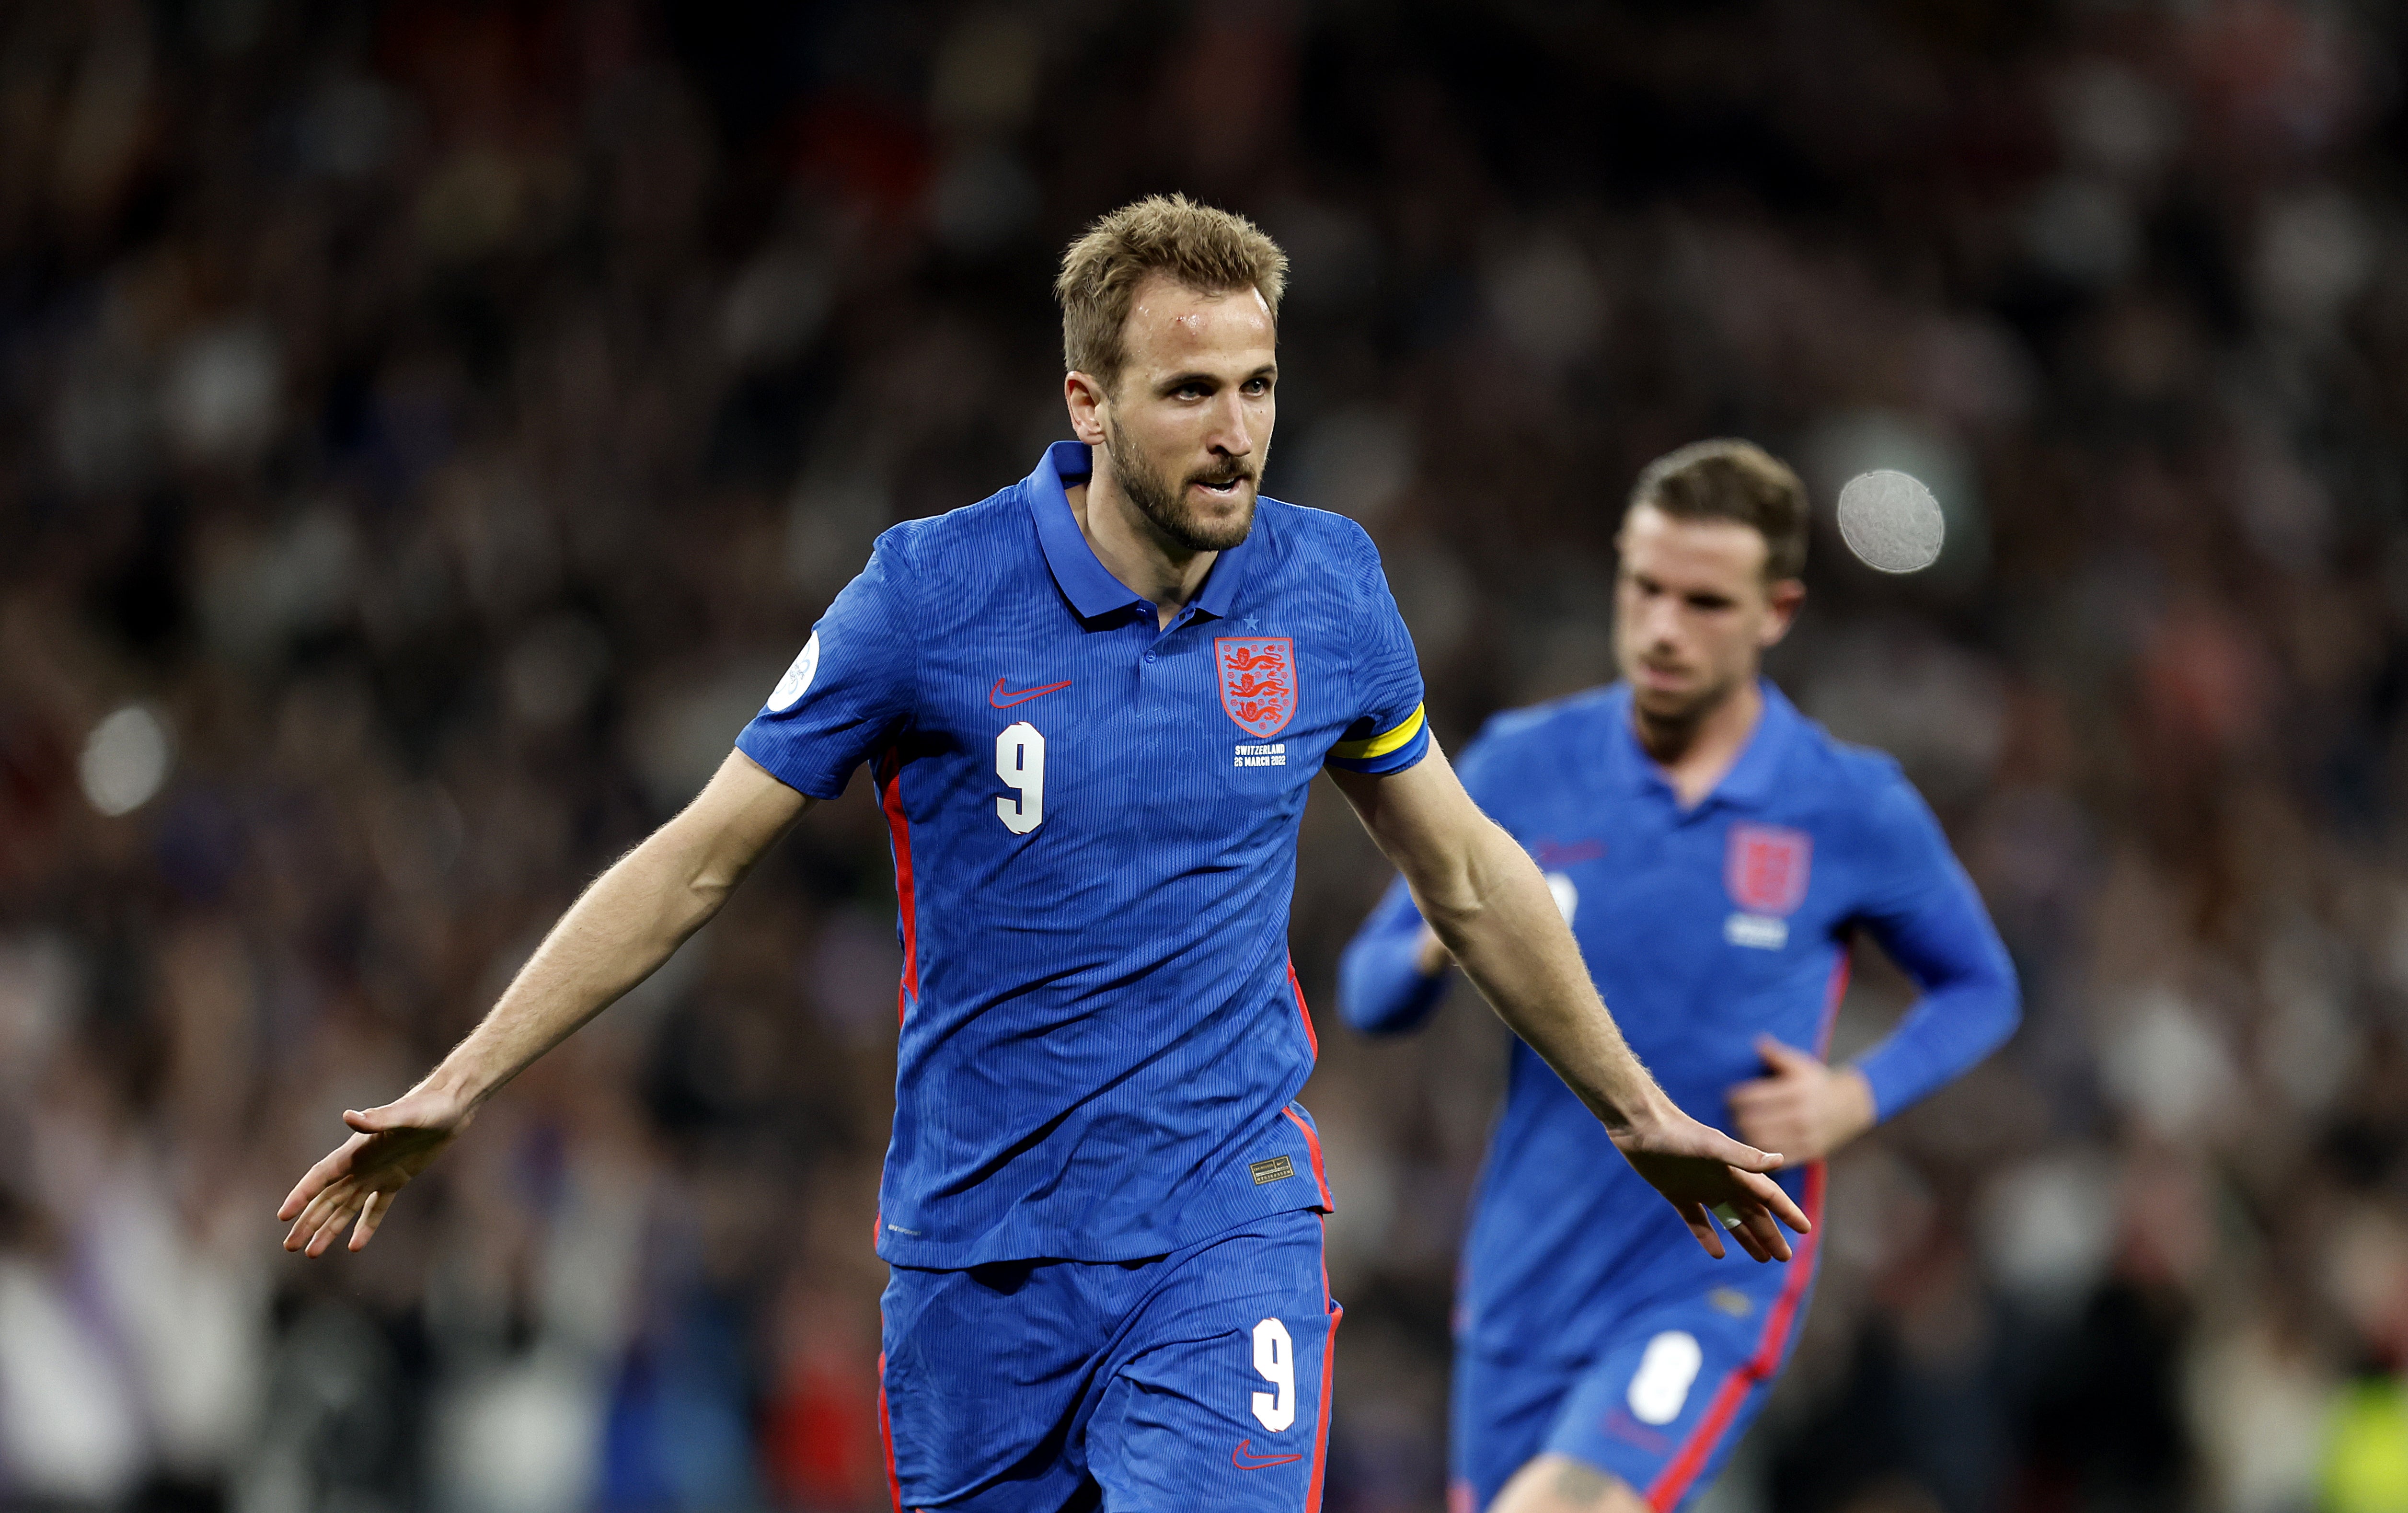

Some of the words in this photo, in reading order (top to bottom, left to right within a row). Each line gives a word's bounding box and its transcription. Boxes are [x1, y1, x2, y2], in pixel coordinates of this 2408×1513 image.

[996, 721, 1045, 834] 9
[1234, 757, 1243, 767] 26
[1244, 756, 1270, 767] MARCH
[1271, 755, 1286, 766] 2022
[1235, 744, 1285, 755] SWITZERLAND
[1252, 1317, 1295, 1432] 9
[1627, 1330, 1703, 1425] 8
